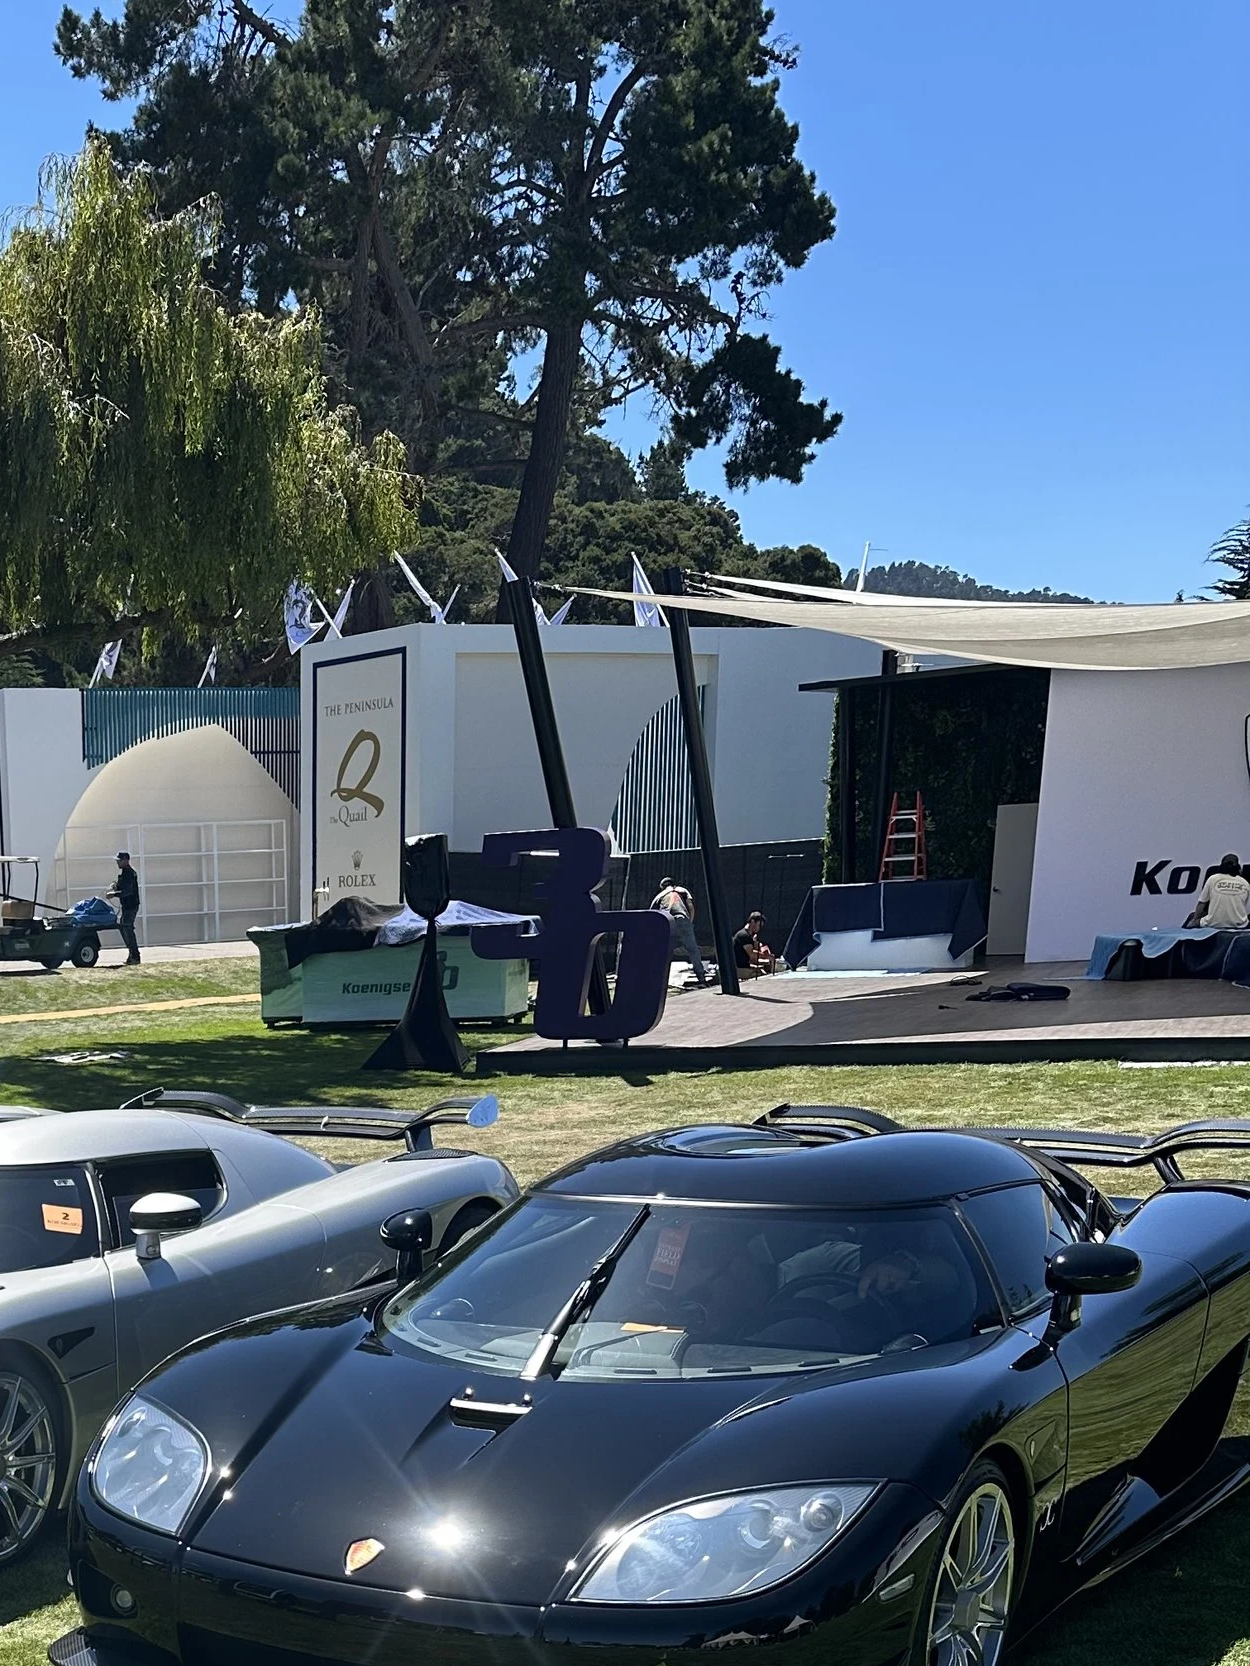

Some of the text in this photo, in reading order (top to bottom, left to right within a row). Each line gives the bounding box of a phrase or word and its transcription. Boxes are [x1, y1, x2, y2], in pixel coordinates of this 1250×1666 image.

[324, 697, 394, 717] THE PENINSULA
[338, 805, 368, 828] Quail
[338, 874, 376, 888] ROLEX
[62, 1212, 70, 1221] 2
